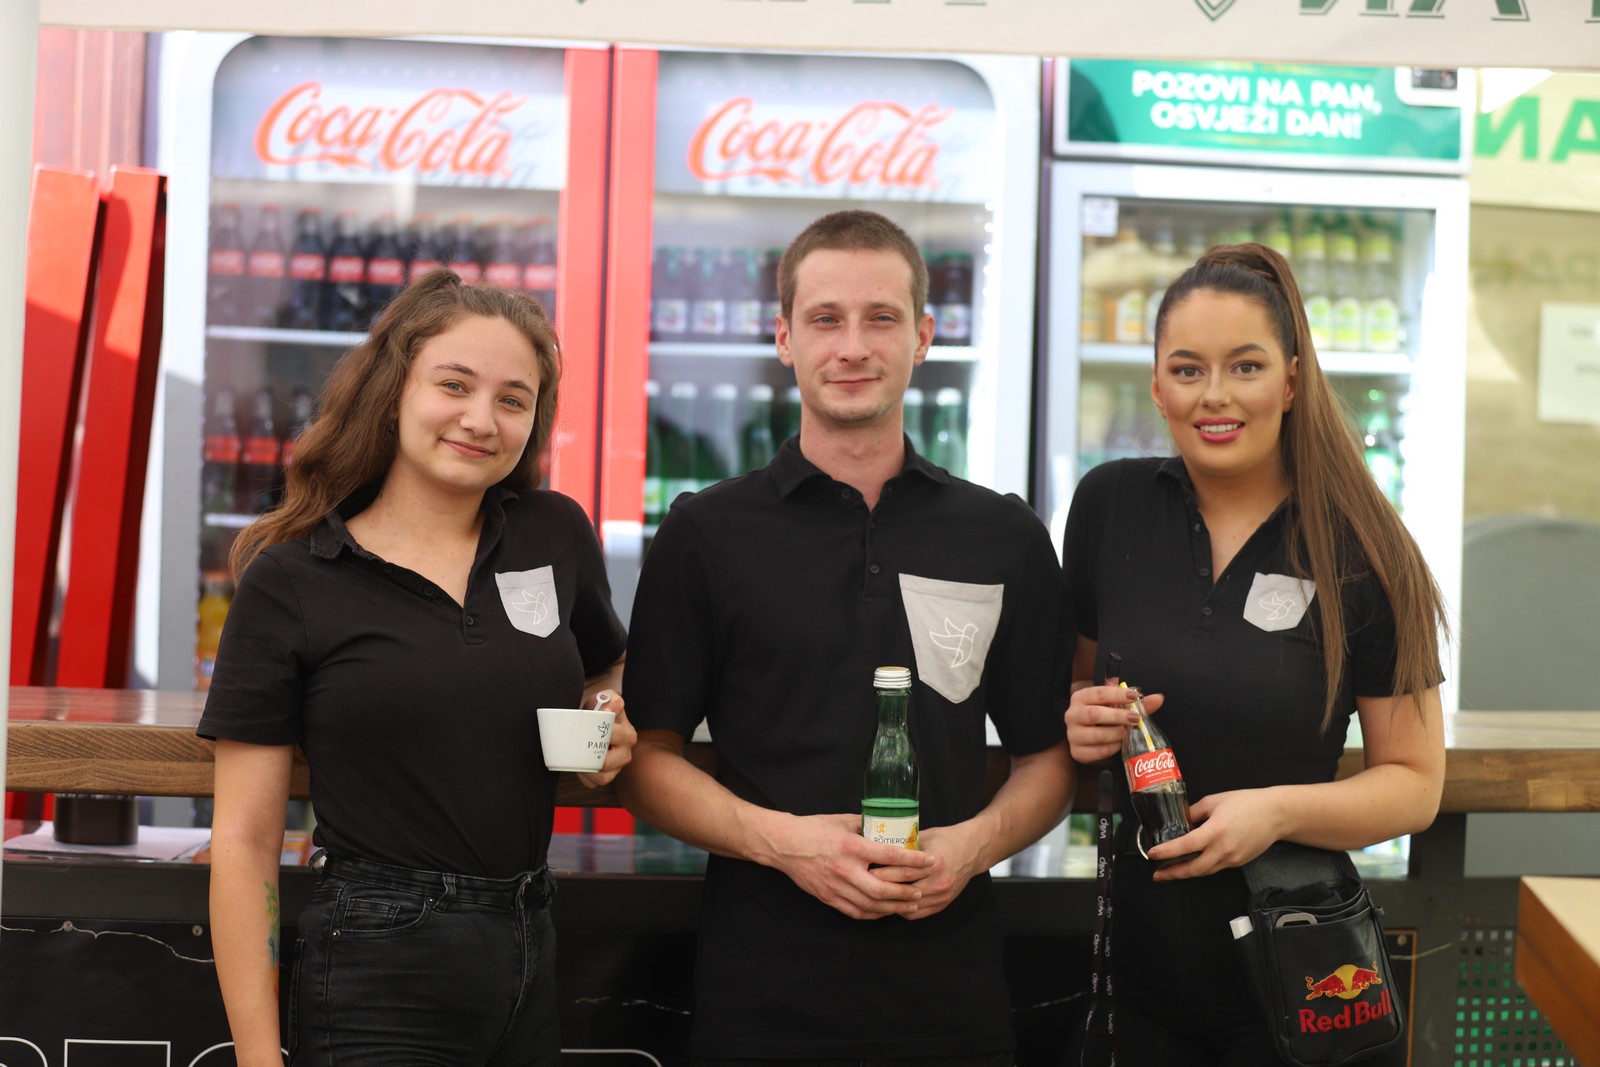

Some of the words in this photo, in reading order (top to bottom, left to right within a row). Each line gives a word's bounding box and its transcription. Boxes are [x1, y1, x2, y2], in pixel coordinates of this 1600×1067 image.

[1132, 69, 1250, 103] POZOVI
[1256, 77, 1304, 106] NA
[1310, 80, 1383, 115] PAN,
[254, 81, 528, 176] Coca-Cola
[687, 96, 956, 188] Coca-Cola
[1150, 101, 1279, 134] OSVJEŽI
[1285, 108, 1363, 140] DAN!
[1134, 751, 1175, 778] Coca-Cola
[1298, 1004, 1351, 1033] Red
[1354, 988, 1392, 1026] Bull
